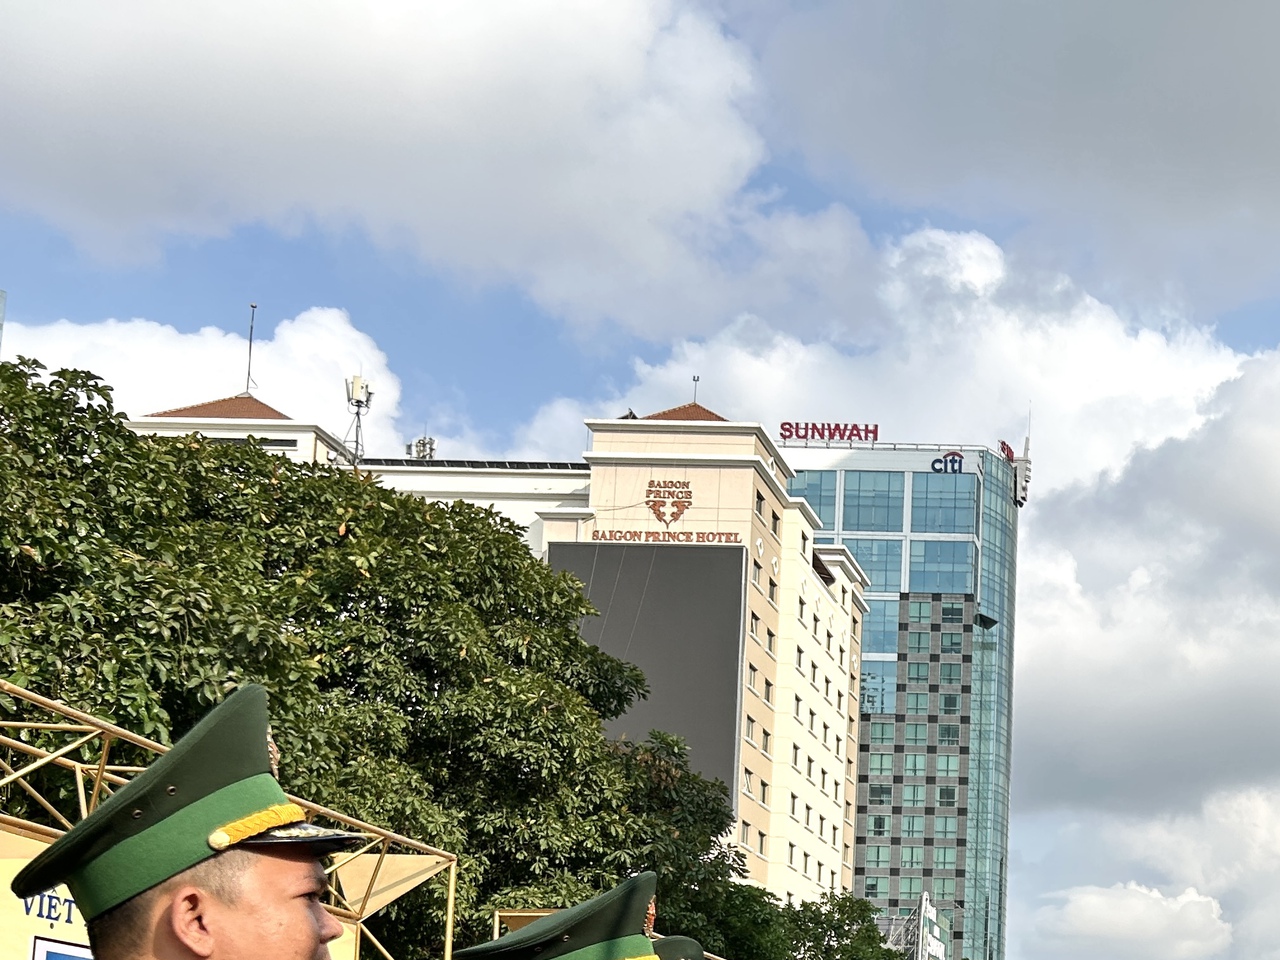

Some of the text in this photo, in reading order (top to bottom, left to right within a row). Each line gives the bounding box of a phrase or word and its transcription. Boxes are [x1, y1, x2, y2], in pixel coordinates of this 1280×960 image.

[780, 422, 878, 441] SUNWAH
[931, 452, 964, 473] citi
[648, 480, 690, 489] SAIGON
[646, 490, 692, 500] PRINCE
[592, 530, 742, 544] SAIGON PRINCE HOTEL
[23, 888, 77, 930] VIỆT
